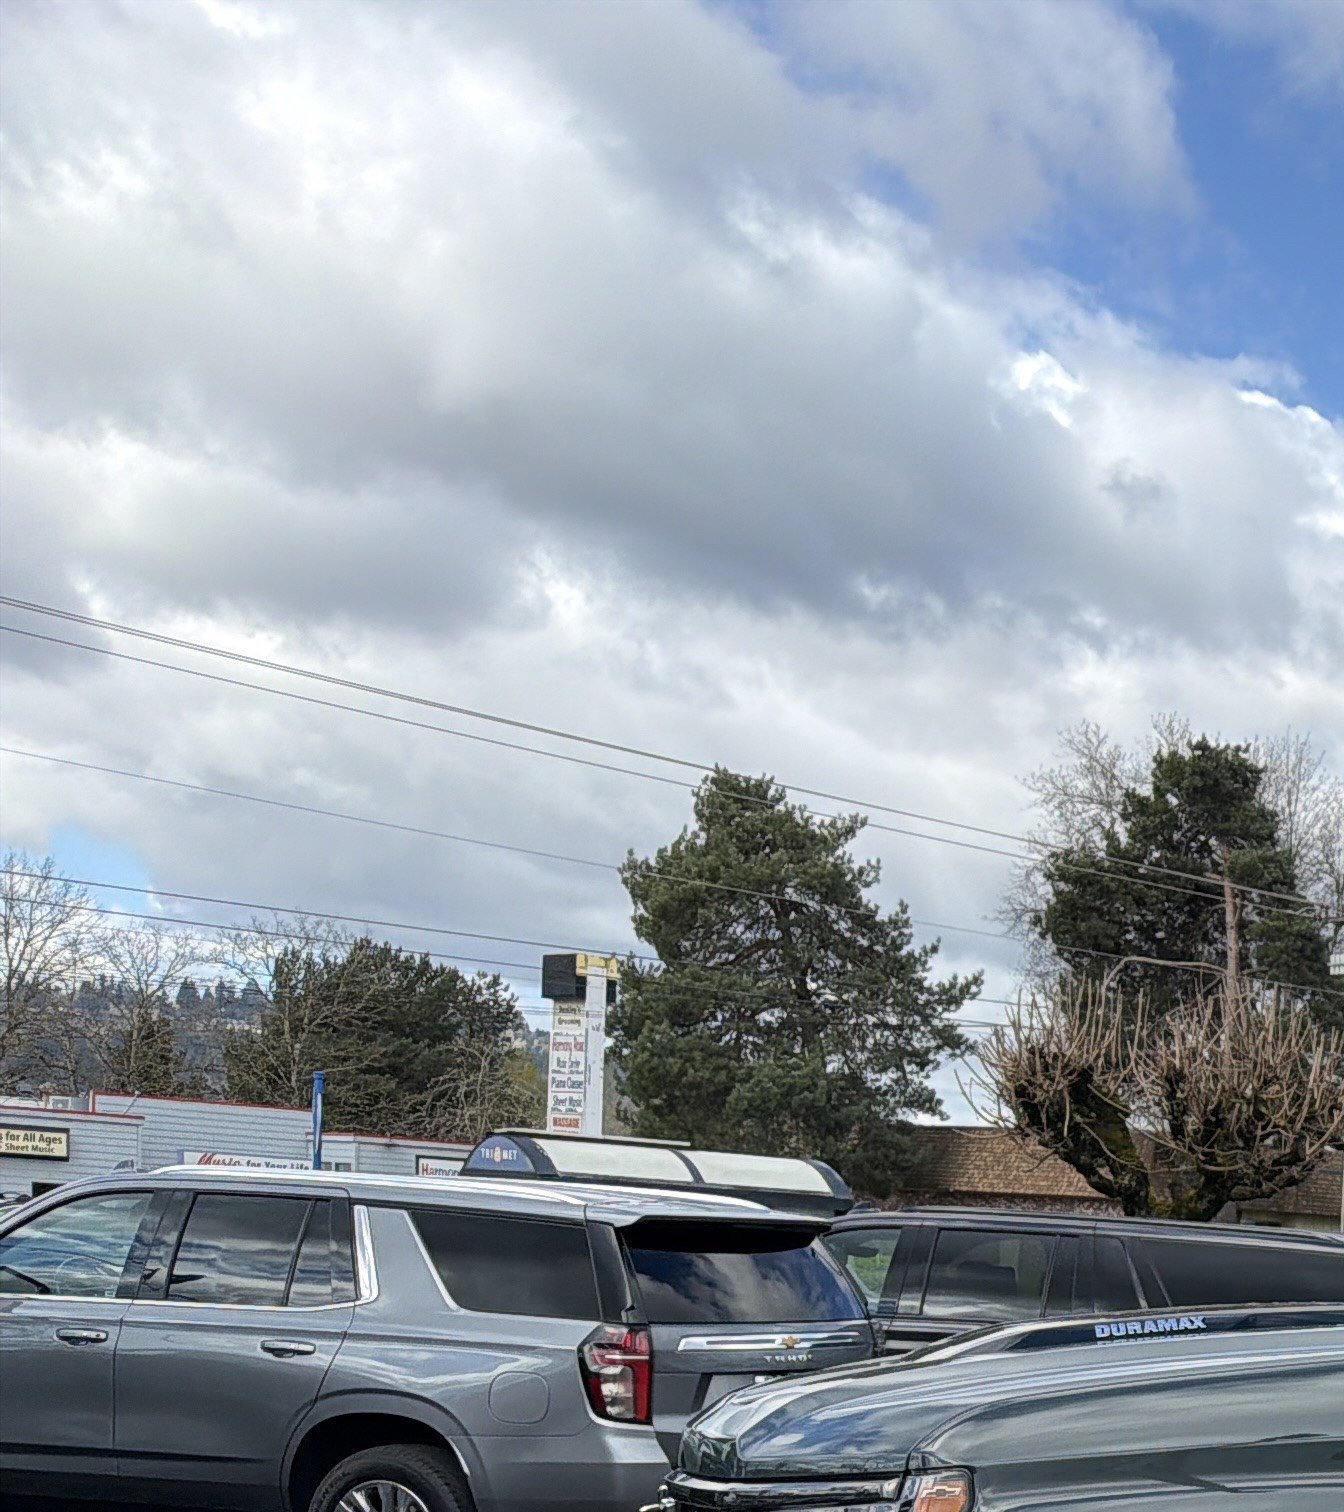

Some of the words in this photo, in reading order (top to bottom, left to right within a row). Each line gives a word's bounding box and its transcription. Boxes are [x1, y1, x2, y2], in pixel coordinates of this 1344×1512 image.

[5, 1131, 20, 1142] for
[23, 1133, 36, 1143] All
[38, 1134, 63, 1146] Ages
[4, 1143, 29, 1152] Sheet
[31, 1144, 55, 1153] Music
[421, 1163, 460, 1176] Harmon
[1094, 1316, 1207, 1338] DURAMAX
